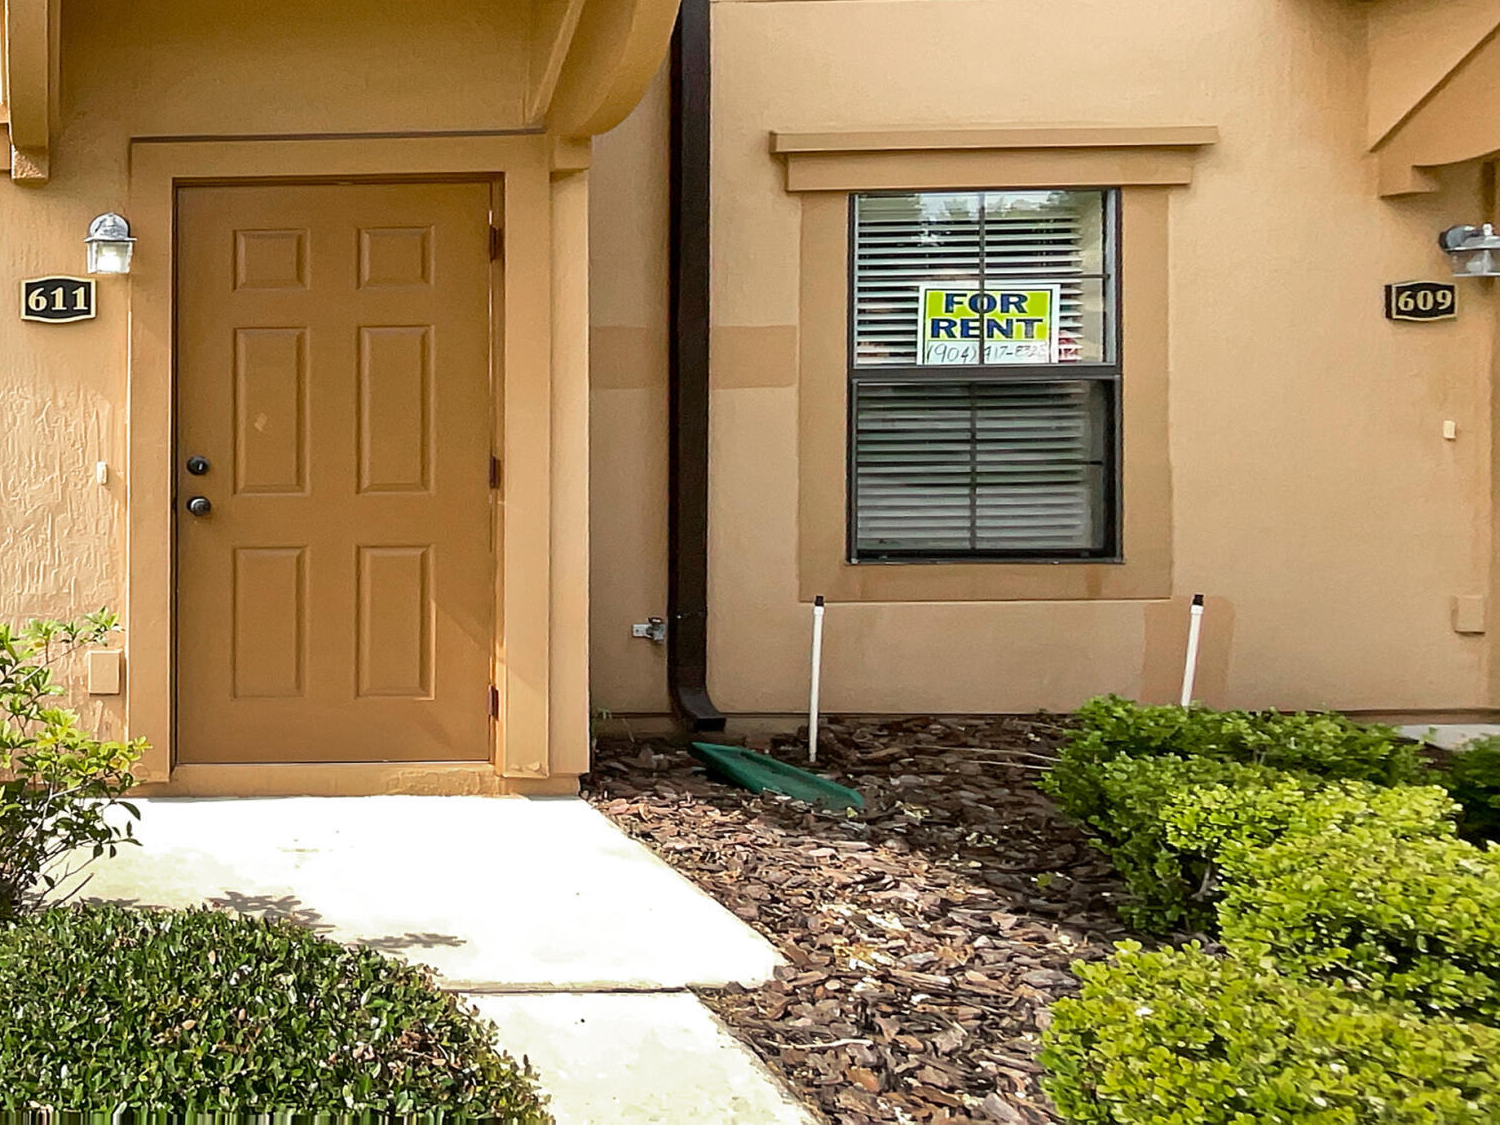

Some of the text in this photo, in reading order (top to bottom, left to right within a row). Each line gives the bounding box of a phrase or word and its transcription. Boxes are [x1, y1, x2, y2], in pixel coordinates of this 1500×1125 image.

[28, 287, 88, 311] 611
[944, 293, 1028, 313] FOR
[1398, 290, 1452, 311] 609
[931, 318, 1043, 339] RENT
[927, 343, 977, 363] (904)
